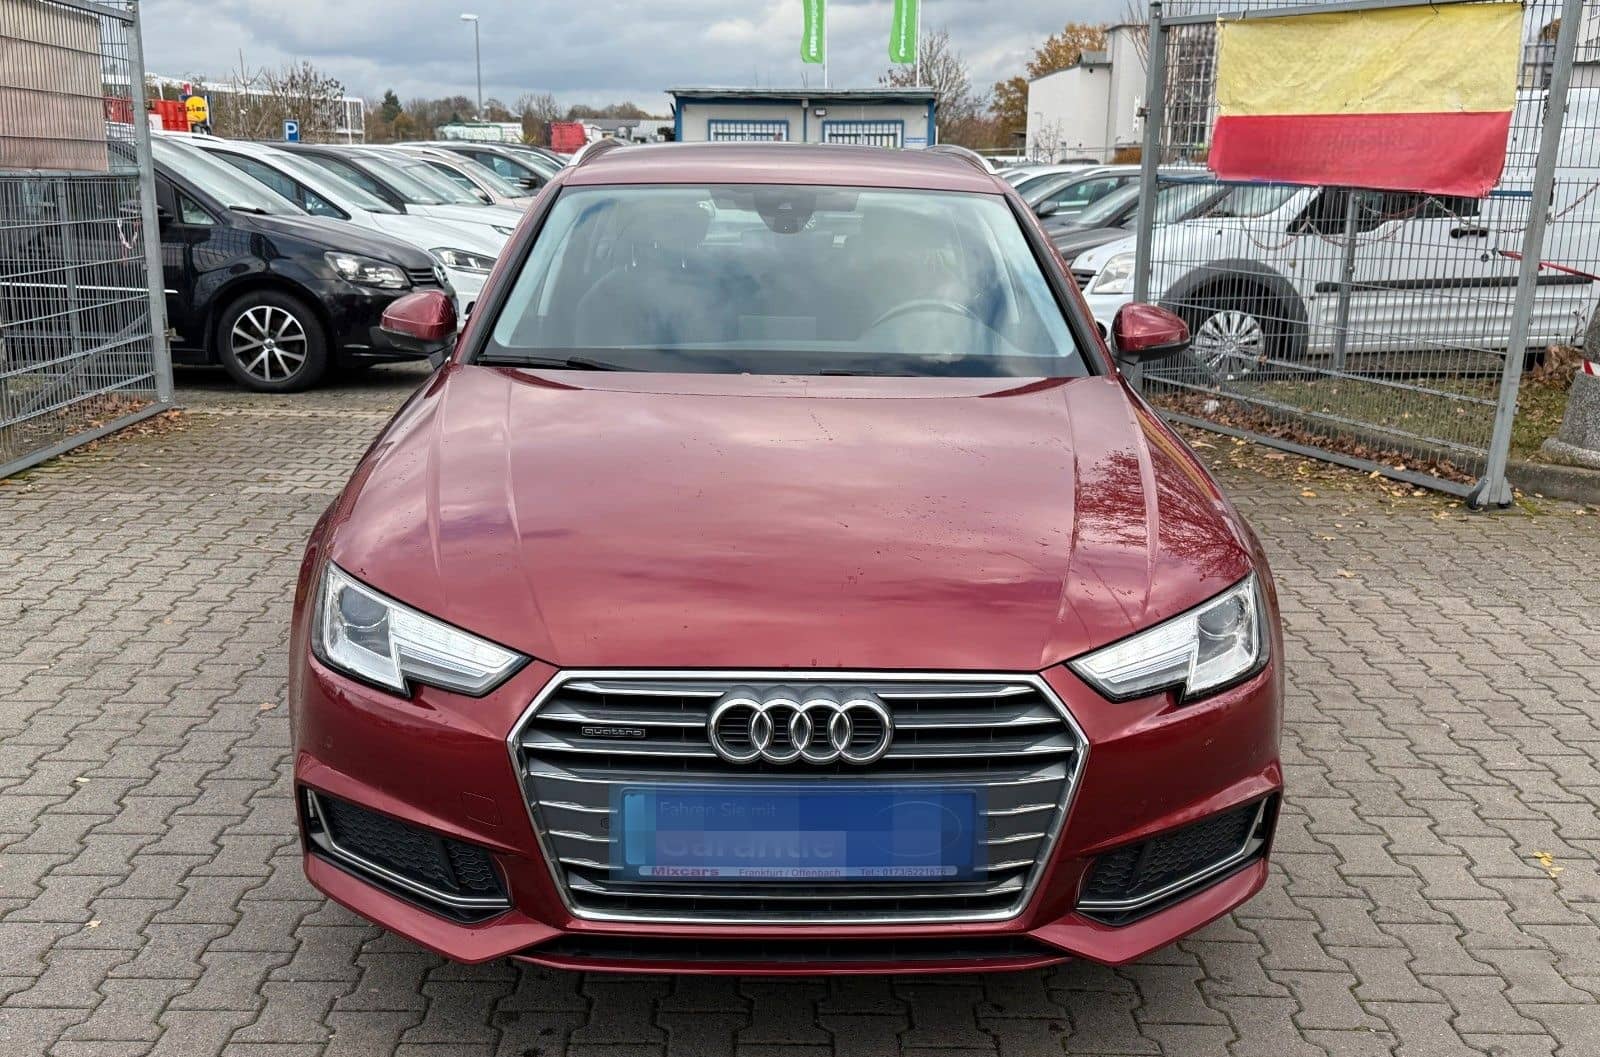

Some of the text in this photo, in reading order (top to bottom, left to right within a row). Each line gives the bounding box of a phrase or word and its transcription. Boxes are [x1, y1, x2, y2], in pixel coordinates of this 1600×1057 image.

[285, 122, 297, 140] P
[585, 727, 642, 736] quattro
[651, 867, 719, 877] Mixcars
